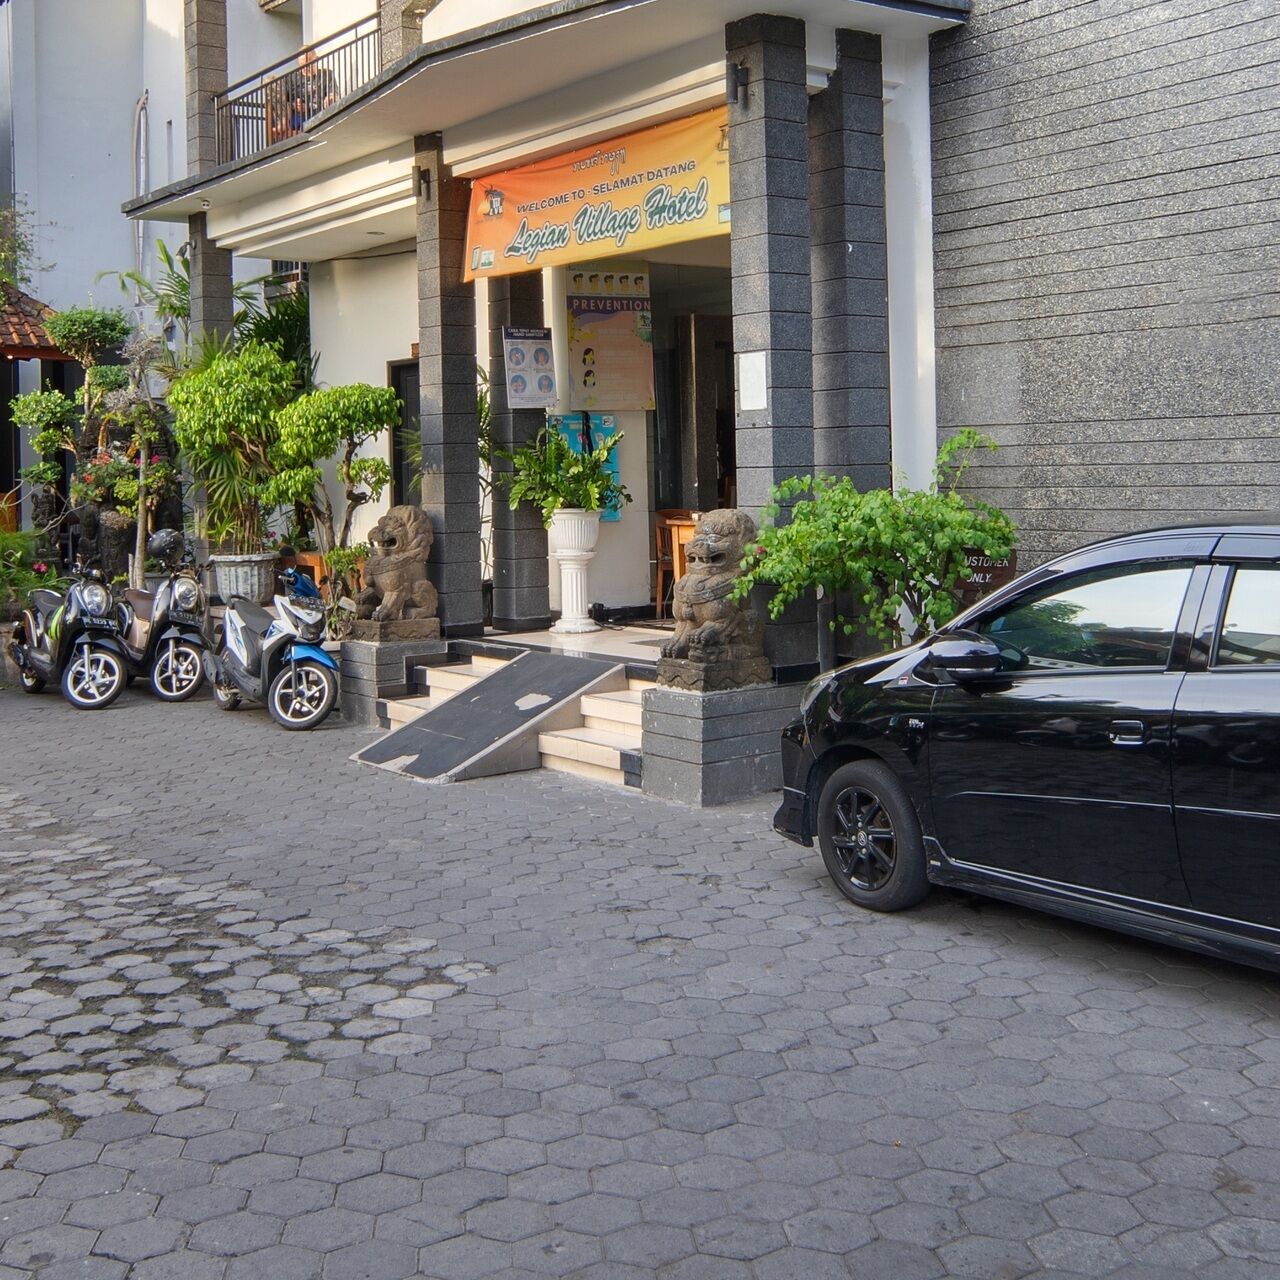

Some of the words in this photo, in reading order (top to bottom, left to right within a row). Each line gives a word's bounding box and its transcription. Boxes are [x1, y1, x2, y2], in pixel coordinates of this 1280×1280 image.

[517, 193, 570, 213] WELCOME
[572, 189, 586, 201] TO
[593, 173, 645, 196] SELAMAT
[647, 160, 696, 182] DATANG
[504, 217, 570, 264] Legian
[573, 201, 641, 247] Village
[644, 176, 708, 230] Hotel
[572, 298, 651, 311] PREVENTION
